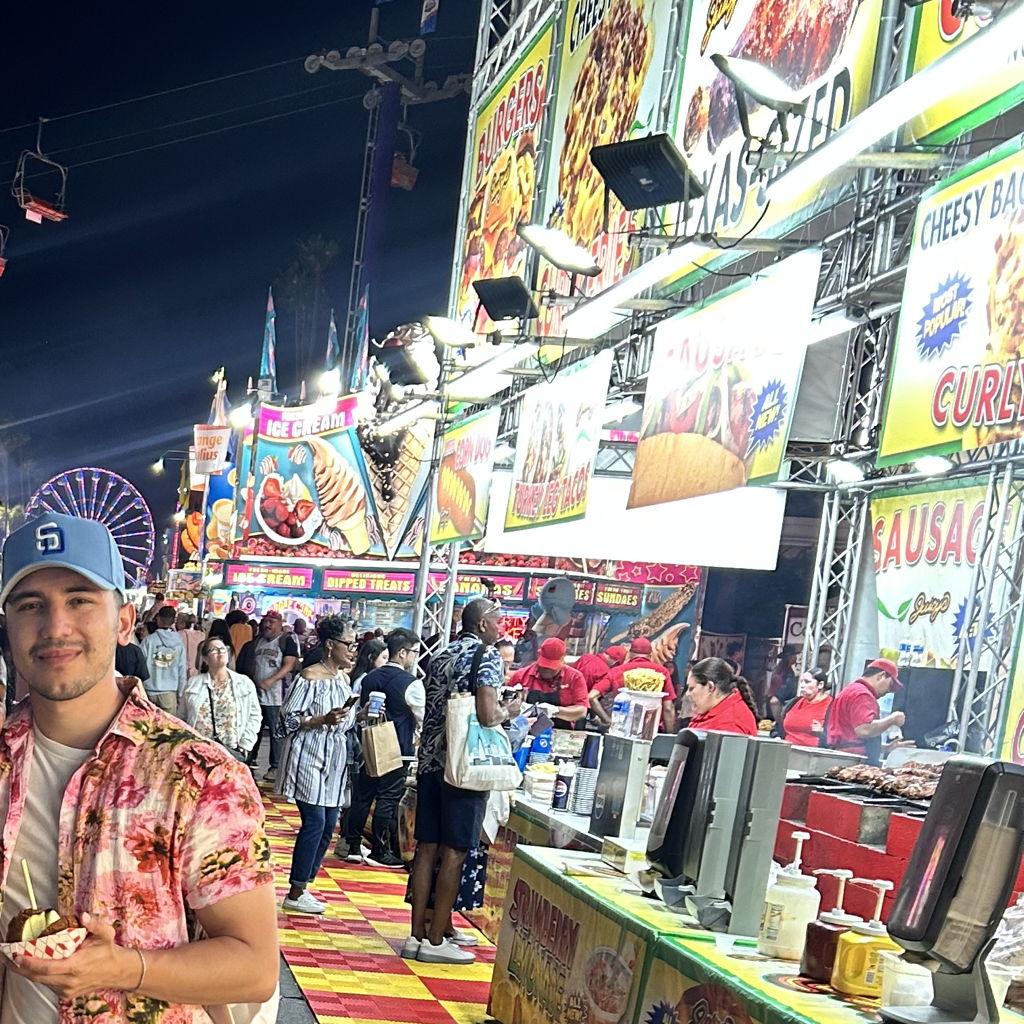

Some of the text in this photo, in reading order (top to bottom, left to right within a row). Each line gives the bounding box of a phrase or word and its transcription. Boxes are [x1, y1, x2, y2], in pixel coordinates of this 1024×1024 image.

[476, 62, 545, 180] BURGERS
[920, 185, 987, 251] CHEESY
[933, 282, 960, 314] MOST
[266, 419, 289, 438] ICE
[291, 411, 346, 438] CREAM
[512, 462, 591, 518] TURKEY LEG TACOS
[872, 499, 1012, 573] SAUSAG
[255, 573, 306, 587] CREAM
[327, 576, 411, 592] DIPPED TREATS
[596, 591, 638, 607] SUNDAES
